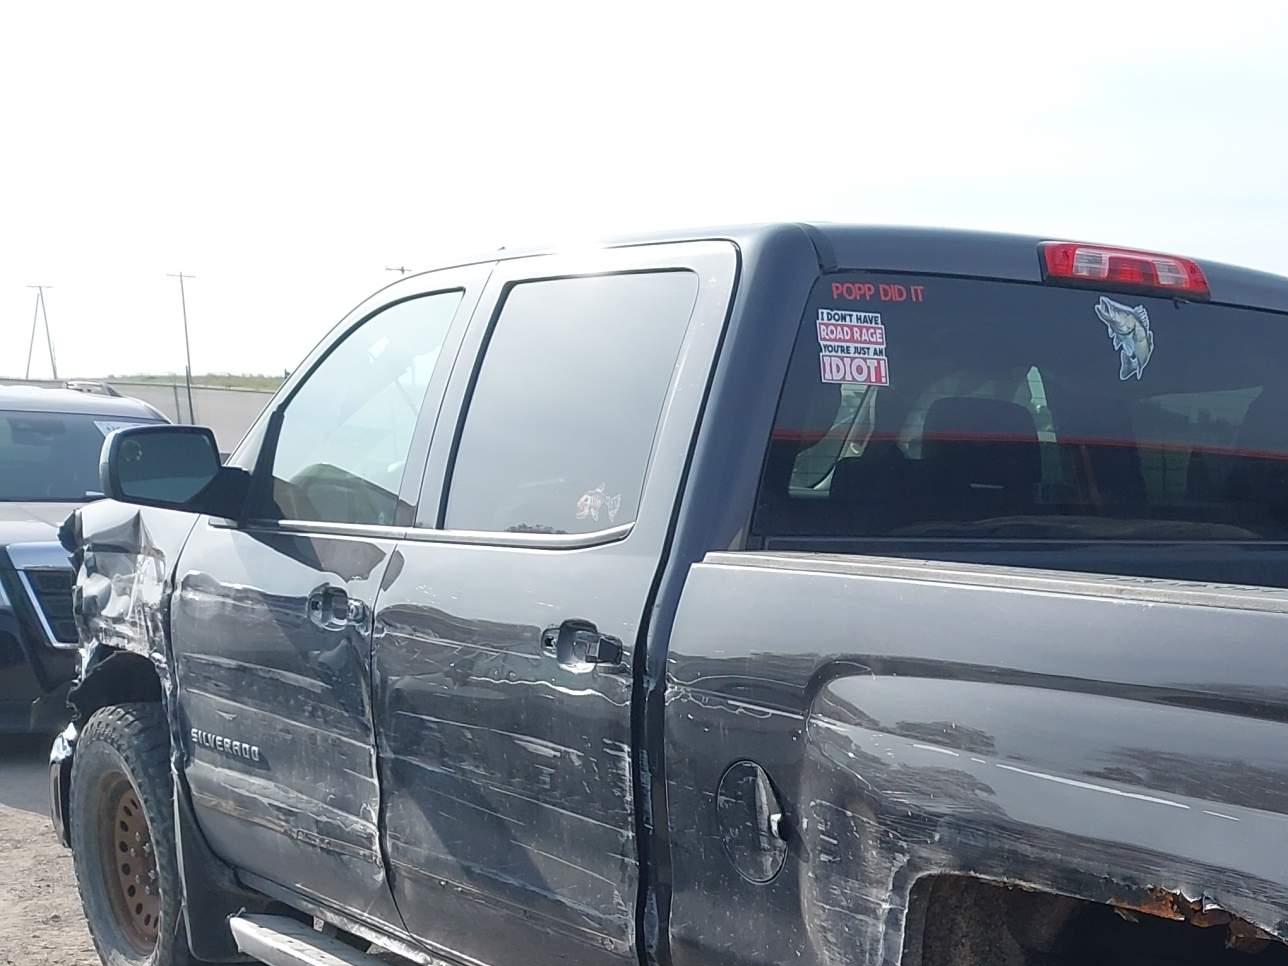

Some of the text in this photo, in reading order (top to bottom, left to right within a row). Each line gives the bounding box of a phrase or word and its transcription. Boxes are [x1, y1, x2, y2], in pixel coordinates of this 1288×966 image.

[832, 282, 924, 302] POPP DID IT
[820, 311, 880, 325] I DON'T HAVE
[820, 324, 883, 342] ROAD RAGE
[822, 343, 884, 357] YOU'RE JUST AN
[822, 357, 887, 383] IDIOT!
[190, 728, 260, 761] SILVERADO
